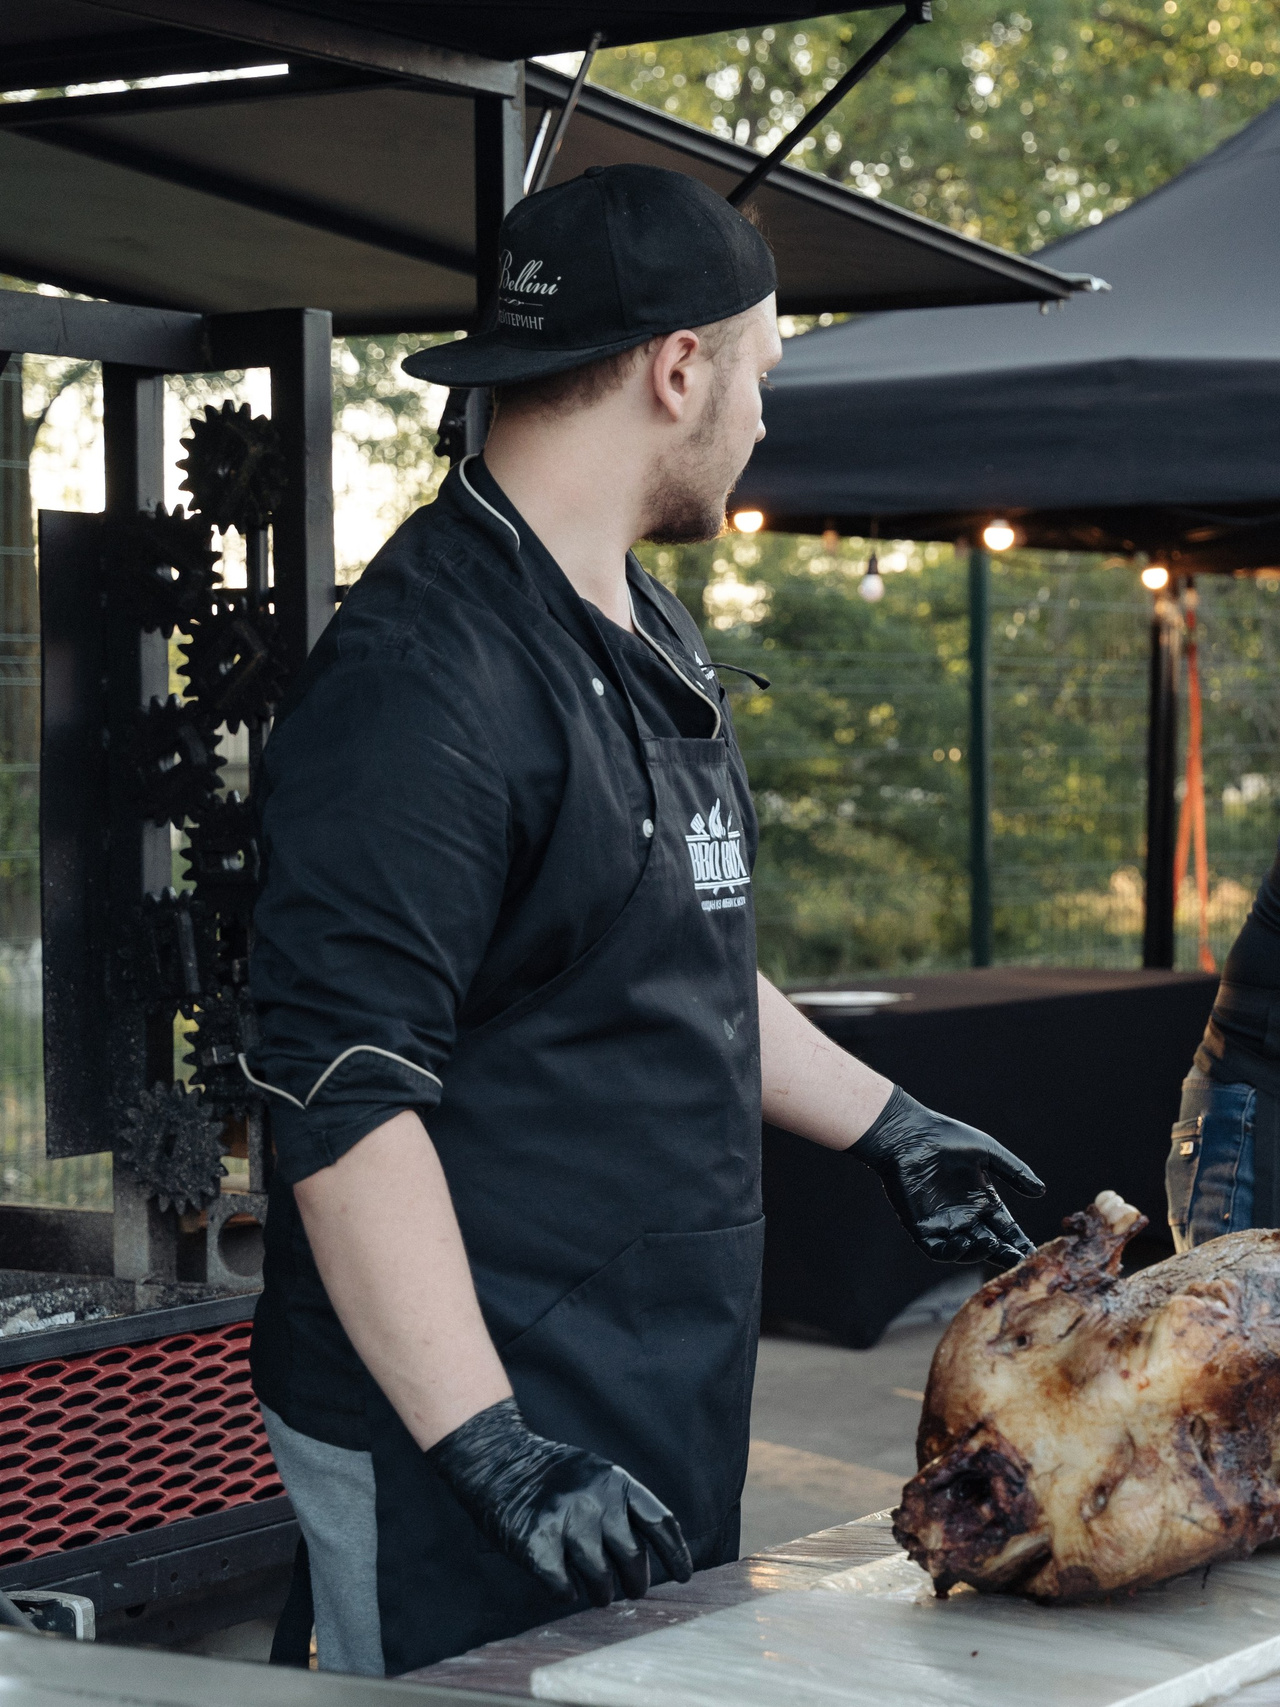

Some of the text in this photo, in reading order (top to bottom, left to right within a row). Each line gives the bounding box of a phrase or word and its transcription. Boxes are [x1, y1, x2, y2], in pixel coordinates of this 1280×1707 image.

[499, 248, 562, 295] Bellini
[687, 839, 748, 881] BBQ BOX
